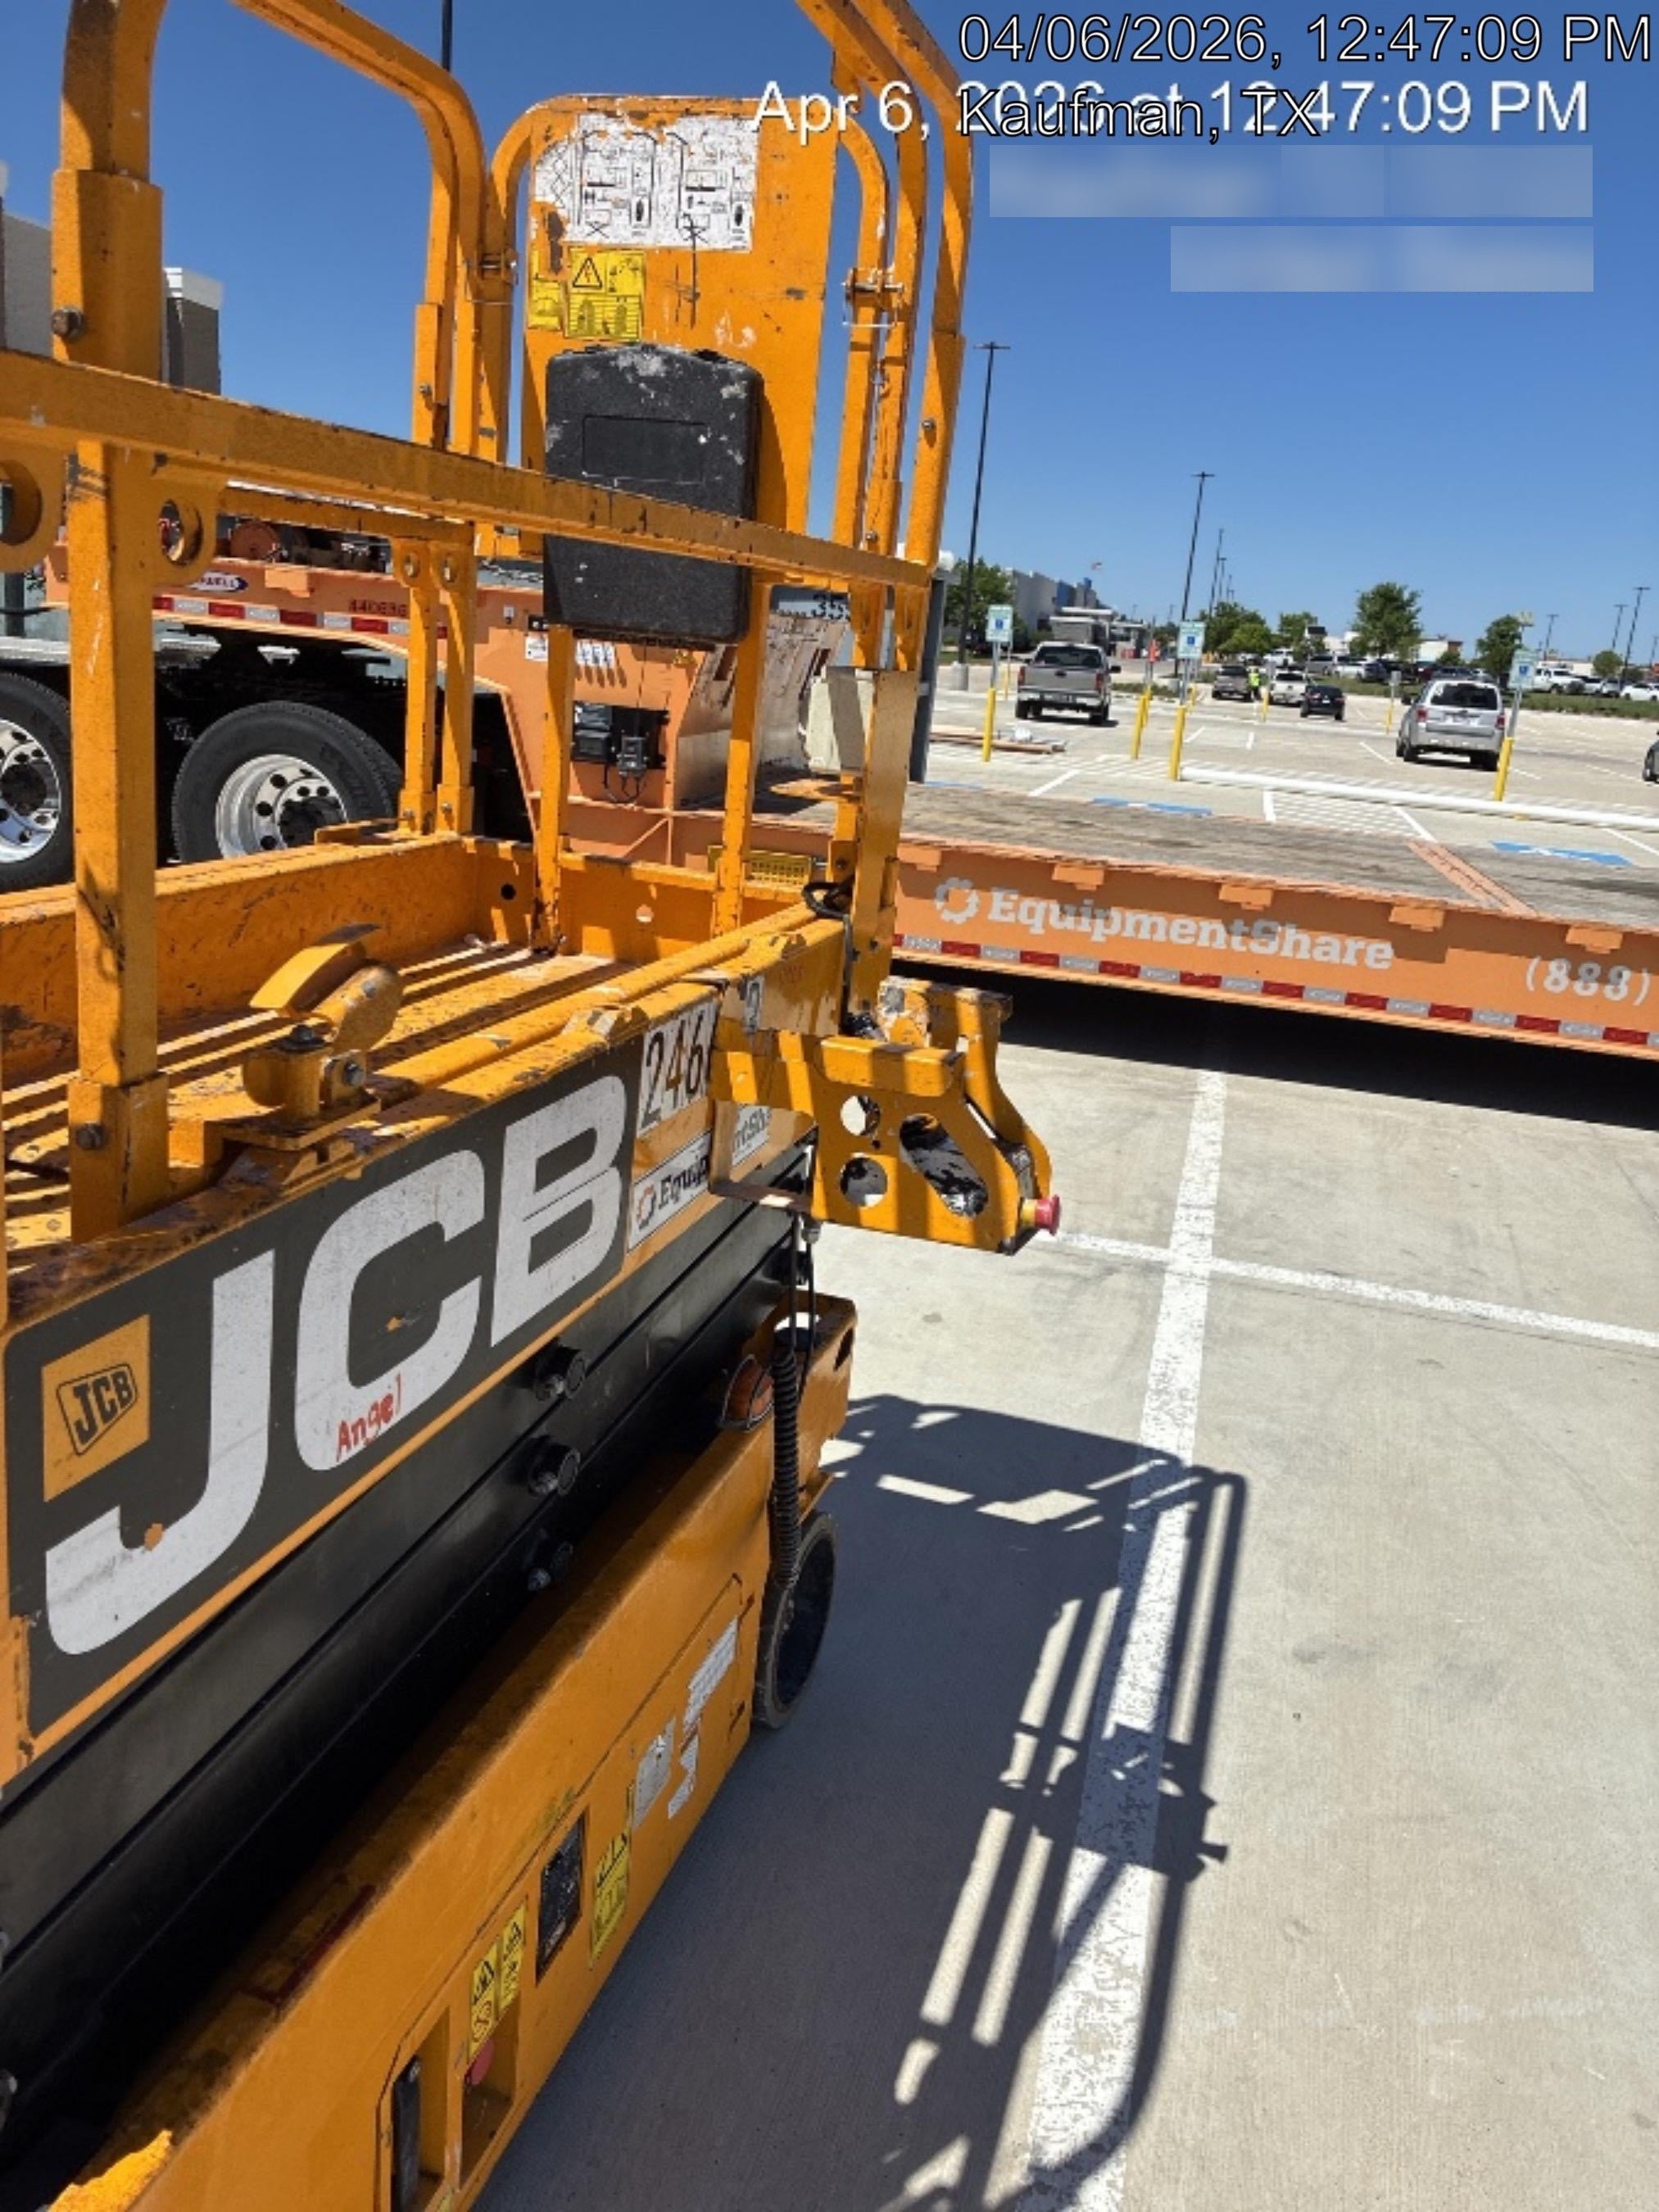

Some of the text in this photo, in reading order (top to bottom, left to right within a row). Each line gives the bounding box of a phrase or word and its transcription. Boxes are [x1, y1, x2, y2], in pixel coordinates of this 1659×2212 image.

[987, 887, 1395, 969] EquipmentShare
[1525, 955, 1651, 1006] (888)
[46, 1075, 627, 1656] JCB
[73, 1370, 134, 1446] JCB
[336, 1373, 402, 1462] Angel
